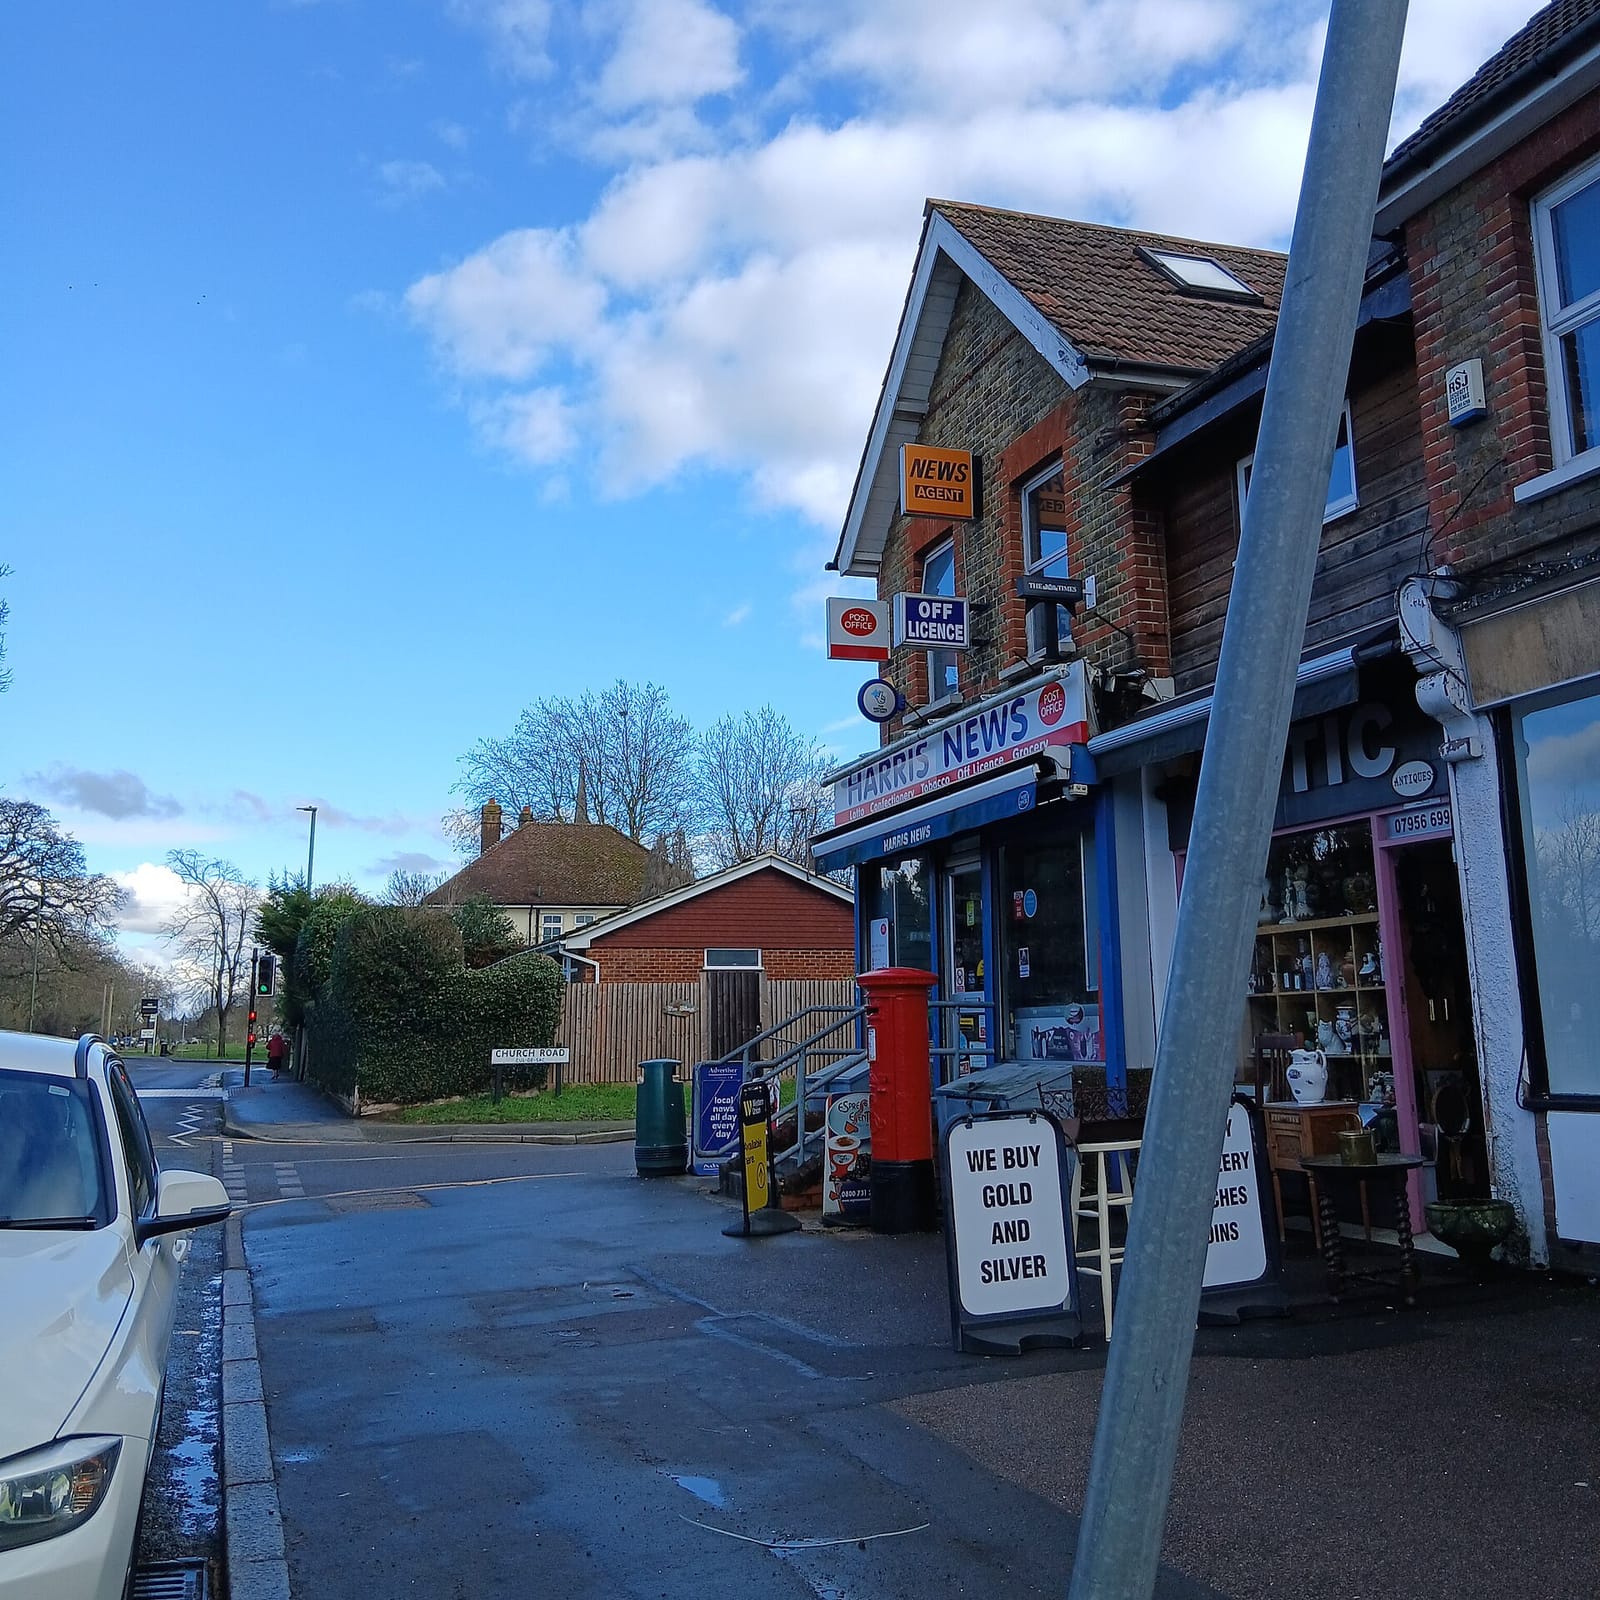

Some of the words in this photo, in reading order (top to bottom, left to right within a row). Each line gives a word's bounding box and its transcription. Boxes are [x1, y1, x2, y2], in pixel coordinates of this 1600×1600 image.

[1449, 375, 1469, 393] RSJ
[910, 458, 969, 483] NEWS
[917, 486, 962, 501] AGENT
[1029, 582, 1043, 590] THE
[1057, 585, 1077, 593] TIMES
[849, 613, 869, 621] POST
[918, 601, 953, 620] OFF
[844, 621, 873, 630] OFFICE
[908, 621, 963, 641] LICENCE
[1043, 689, 1060, 704] POST
[1040, 700, 1063, 718] OFFICE
[847, 742, 930, 806] HARRIS
[943, 697, 1029, 768] NEWS
[849, 808, 865, 821] Lotto
[870, 789, 915, 813] Confectionery
[921, 776, 950, 793] Tobacco
[958, 765, 970, 779] Off
[972, 756, 1004, 774] Licence
[1012, 739, 1049, 760] Grocery
[1394, 770, 1432, 787] ANTIQUES
[1395, 814, 1427, 833] 07956
[1430, 810, 1450, 827] 699
[883, 831, 909, 852] HARRIS
[910, 824, 931, 843] NEWS
[495, 1049, 535, 1058] CHURCH
[540, 1048, 566, 1057] ROAD
[714, 1096, 734, 1104] local
[710, 1113, 720, 1121] all
[721, 1113, 737, 1122] day
[712, 1123, 735, 1132] every
[716, 1130, 731, 1140] day
[967, 1148, 997, 1173] WE
[1003, 1145, 1041, 1169] BUY
[841, 1190, 857, 1198] 0800
[982, 1182, 1033, 1208] GOLD
[991, 1219, 1031, 1246] AND
[980, 1255, 1048, 1284] SILVER
